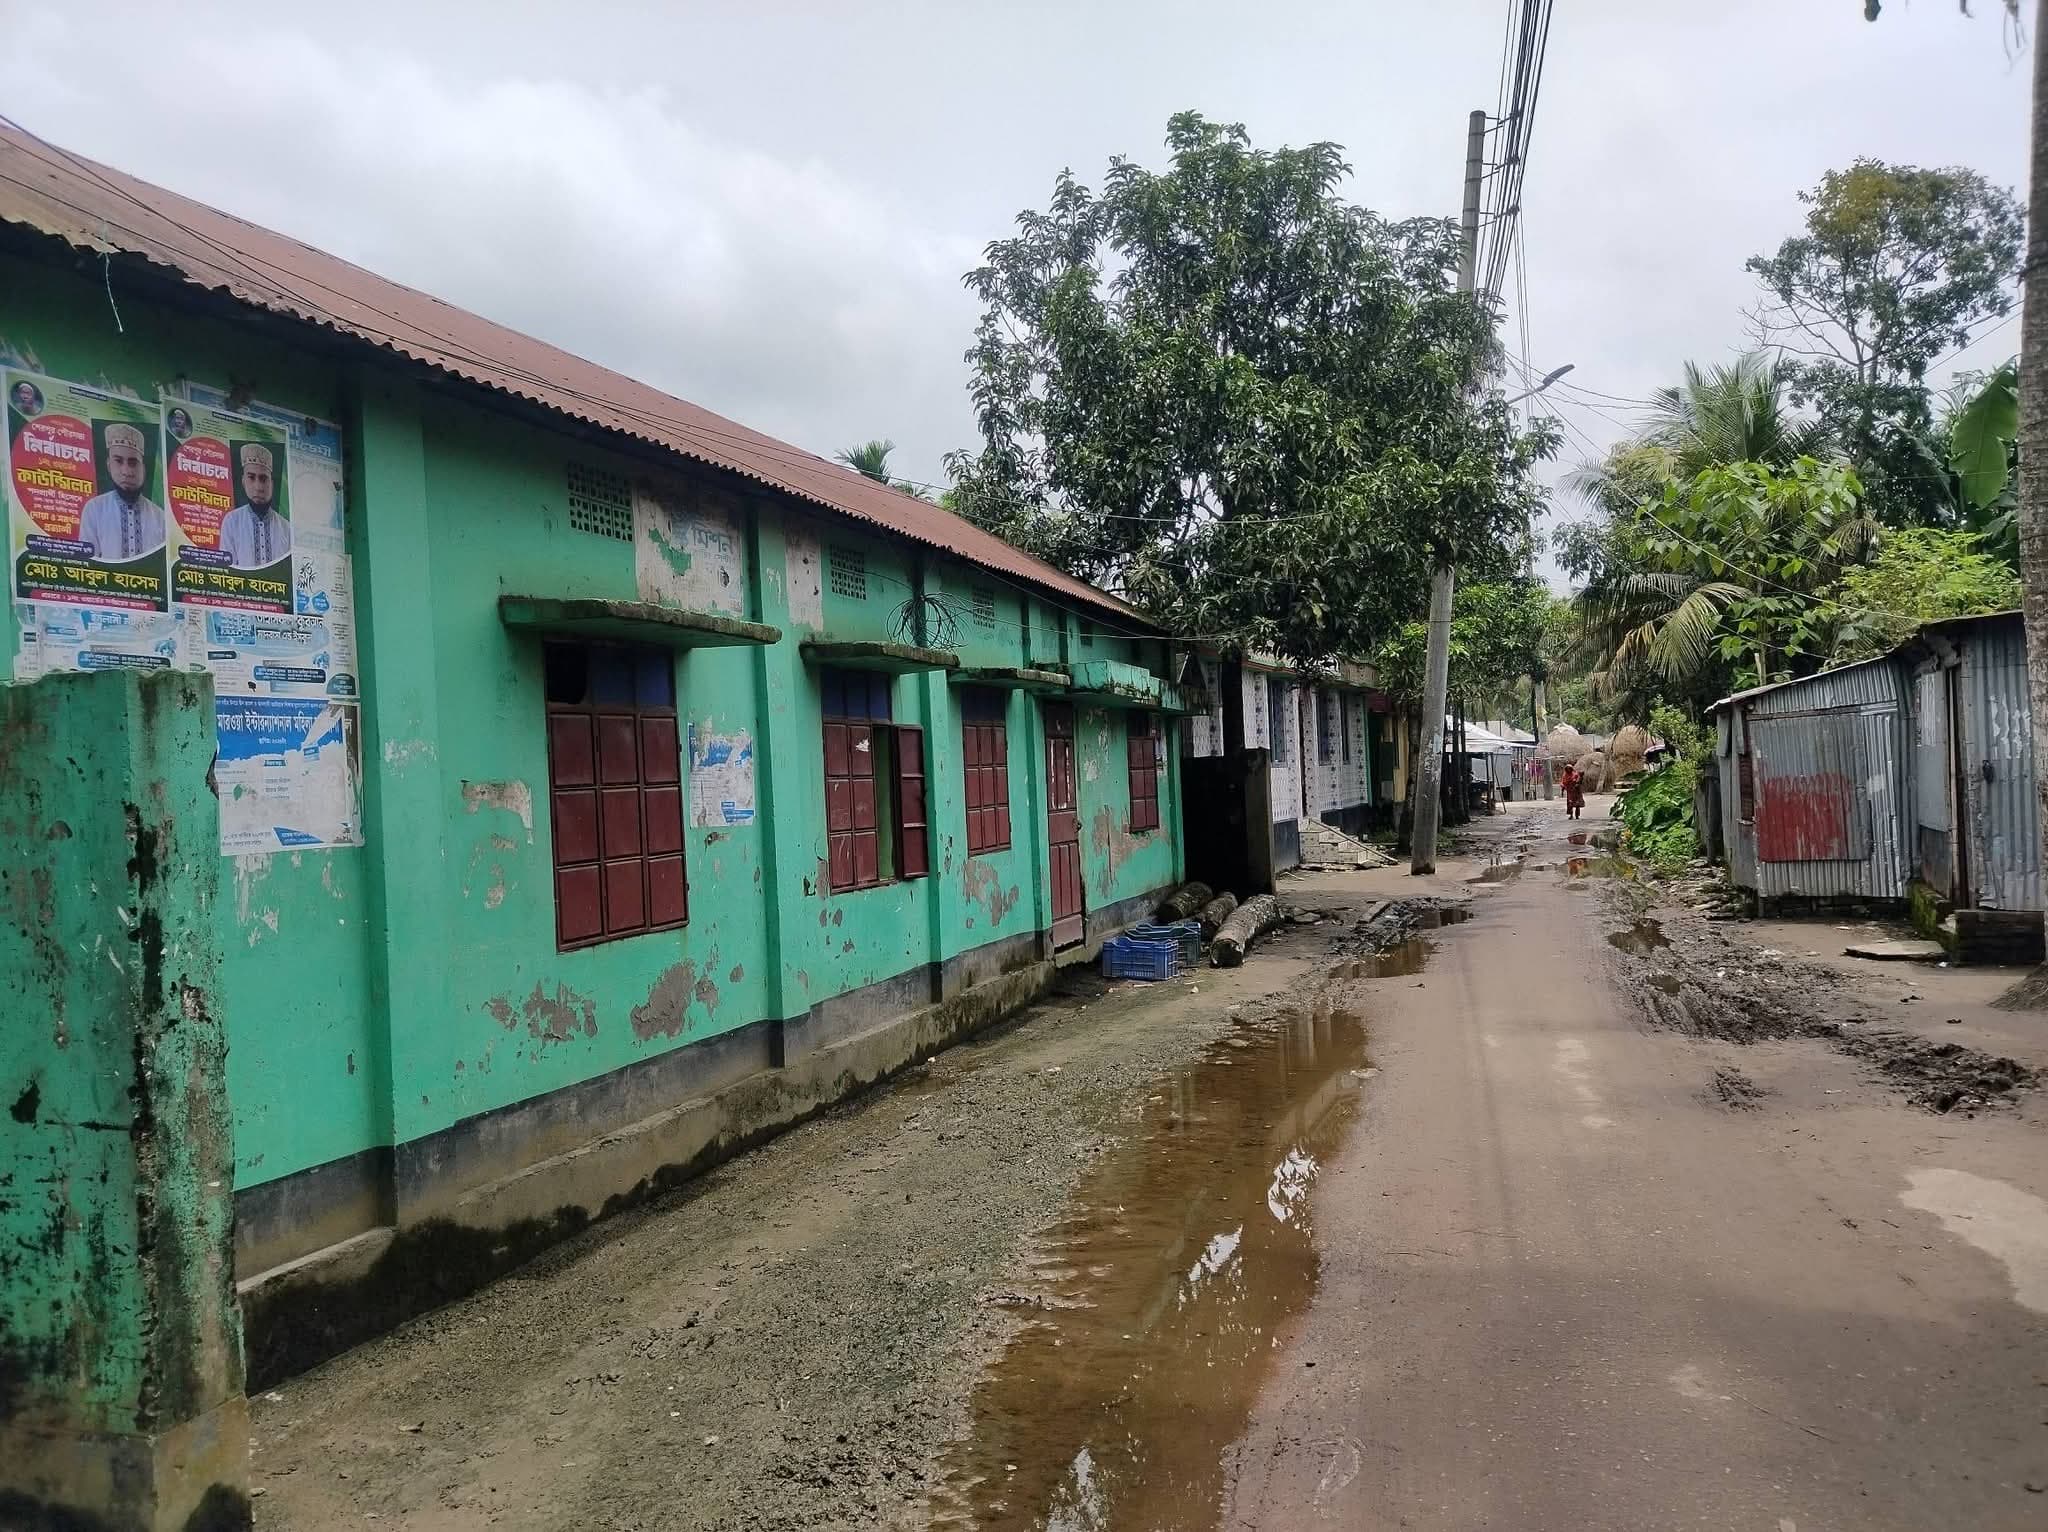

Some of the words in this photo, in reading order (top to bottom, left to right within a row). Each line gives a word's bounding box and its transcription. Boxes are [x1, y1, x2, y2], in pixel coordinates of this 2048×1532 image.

[23, 431, 91, 463] নির্বাচনে
[177, 451, 229, 480] নির্বাচনে
[16, 467, 93, 497] কাউন্সিলর
[171, 485, 232, 512] কাউন্সিলর
[24, 562, 59, 580] মোঃ
[63, 565, 110, 588] আবুল
[112, 571, 161, 592] হাসেম
[178, 569, 205, 585] মোঃ
[207, 573, 245, 593] আবুল
[247, 579, 288, 596] হাসেম
[216, 713, 243, 732] মারওয়া
[244, 710, 292, 734] ইন্টারন্যাশনাল
